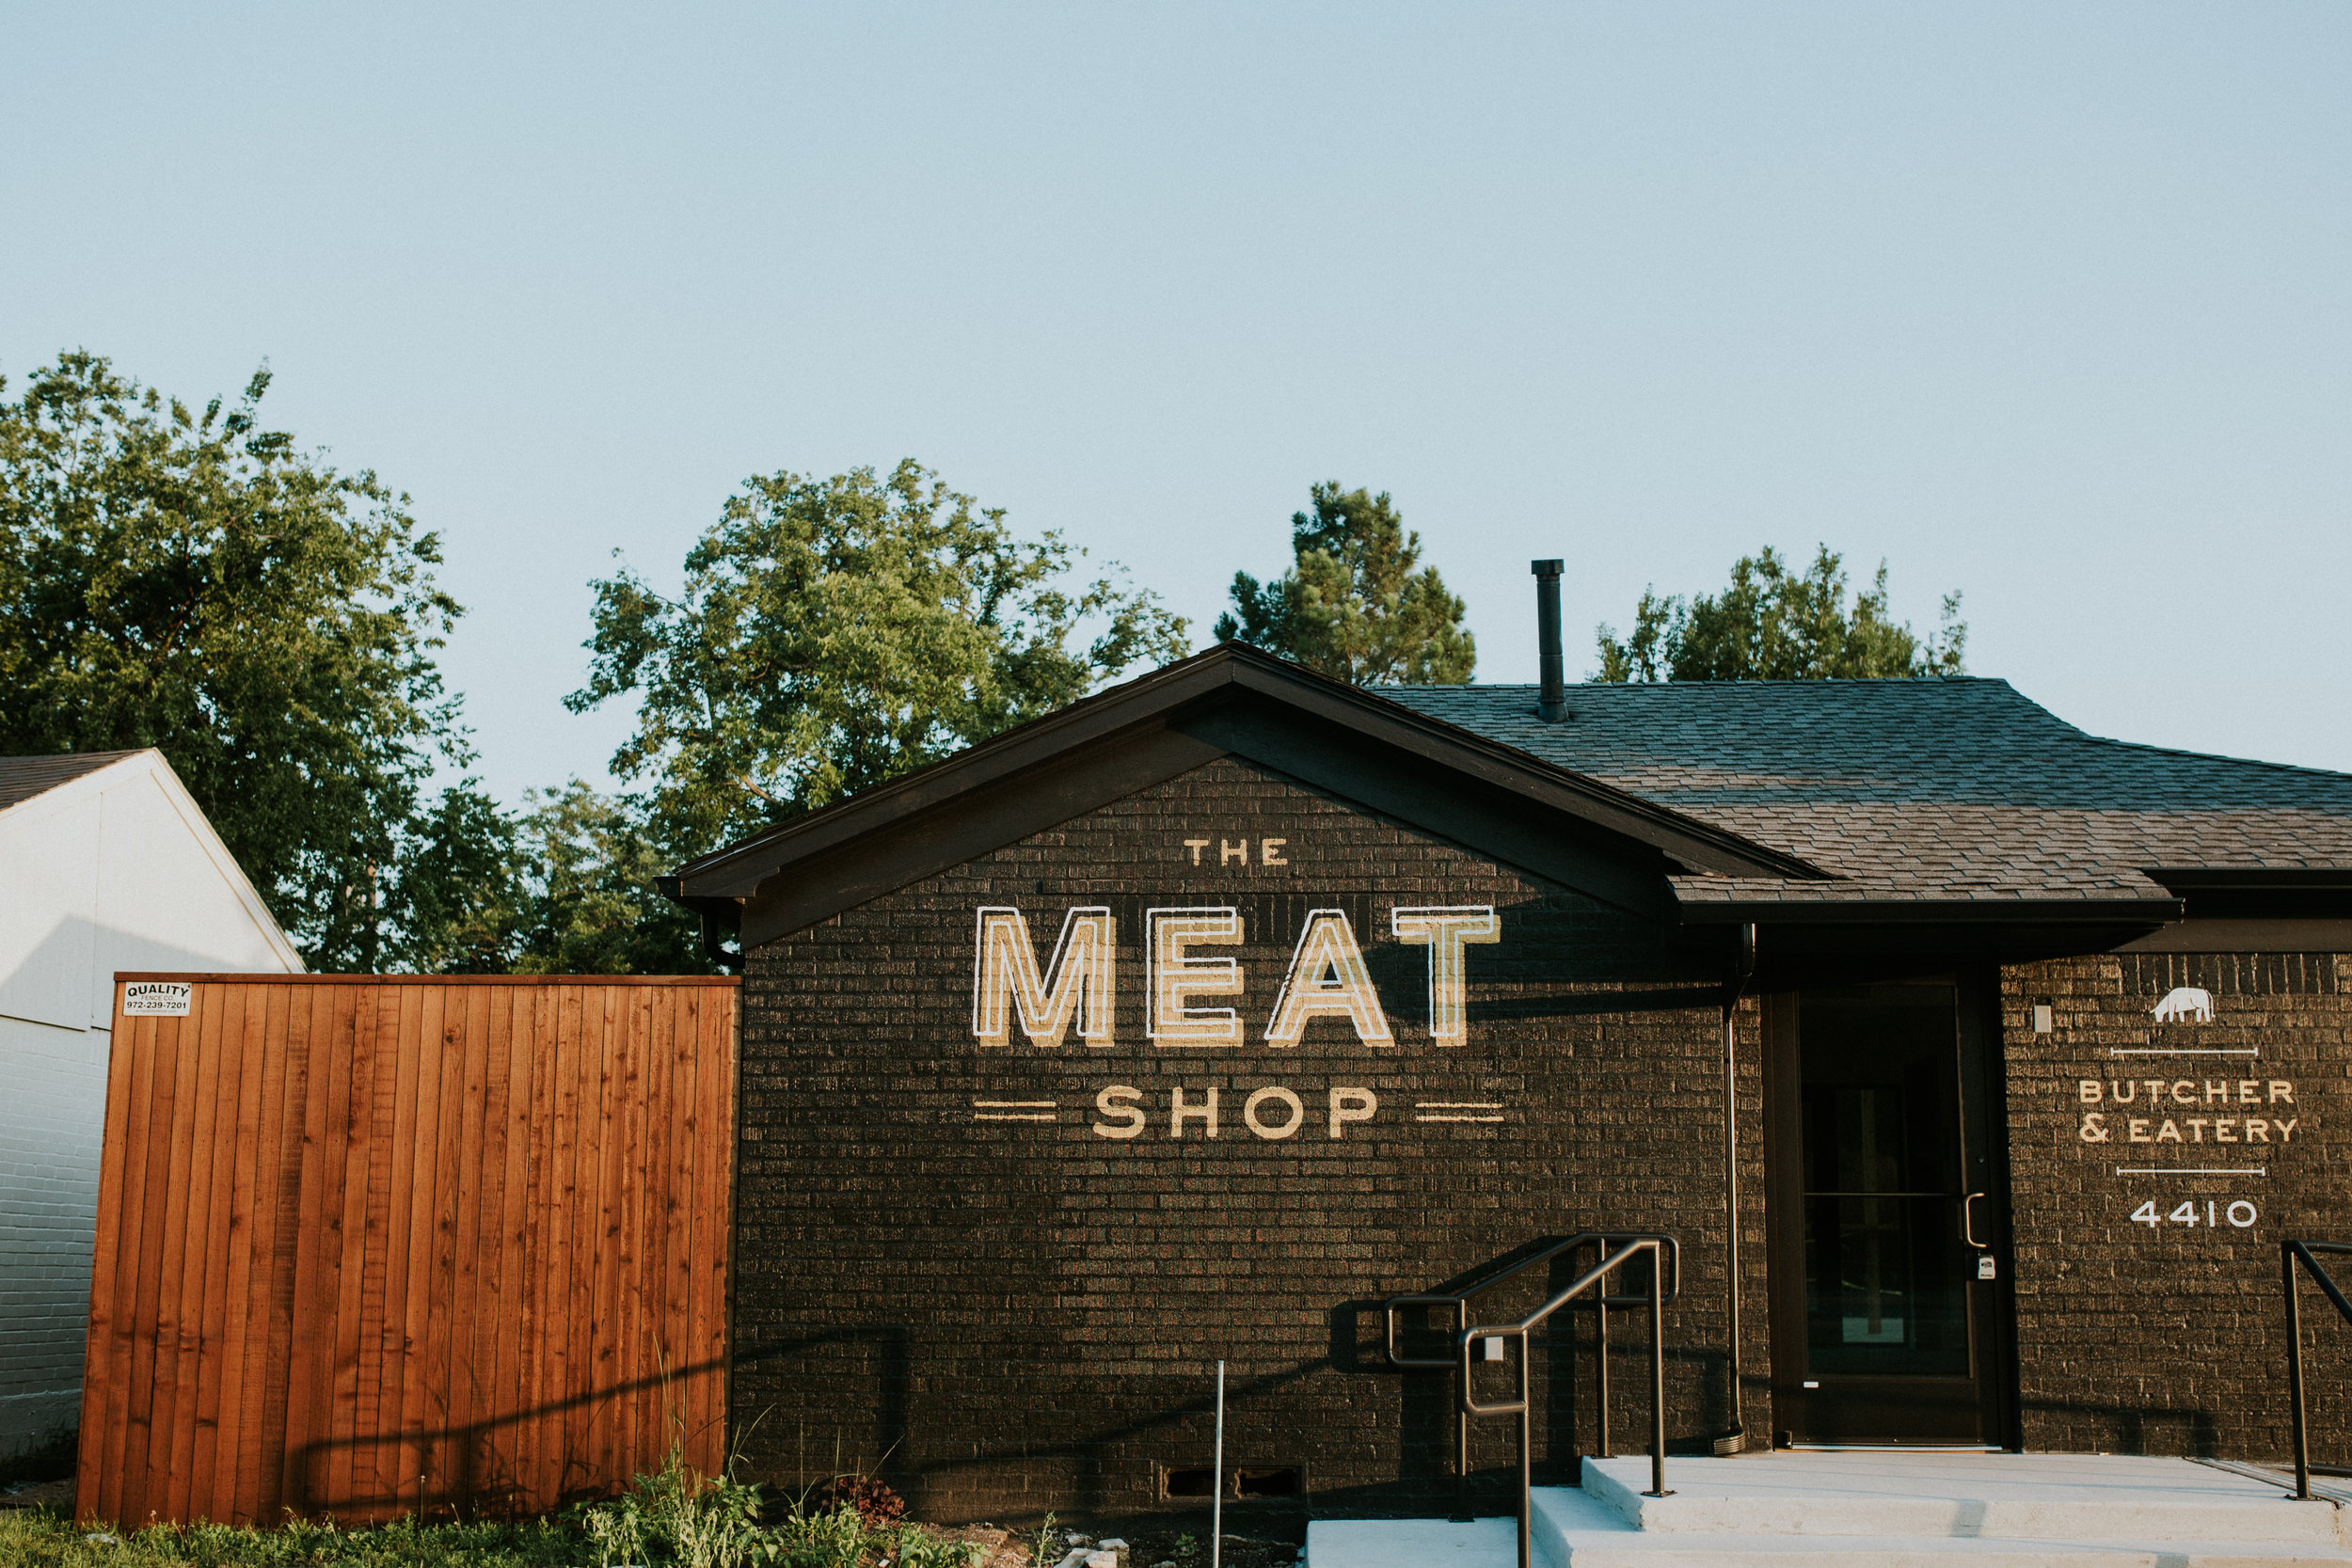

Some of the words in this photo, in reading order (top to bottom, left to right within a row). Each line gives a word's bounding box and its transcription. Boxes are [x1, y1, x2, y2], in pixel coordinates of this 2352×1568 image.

[1184, 838, 1288, 865] THE
[973, 906, 1501, 1047] MEAT
[128, 985, 189, 997] QUALITY
[2079, 1080, 2295, 1103] BUTCHER
[1092, 1085, 1377, 1138] SHOP
[2079, 1114, 2109, 1143] &
[2129, 1118, 2297, 1143] EATERY
[2130, 1200, 2257, 1227] 4410
